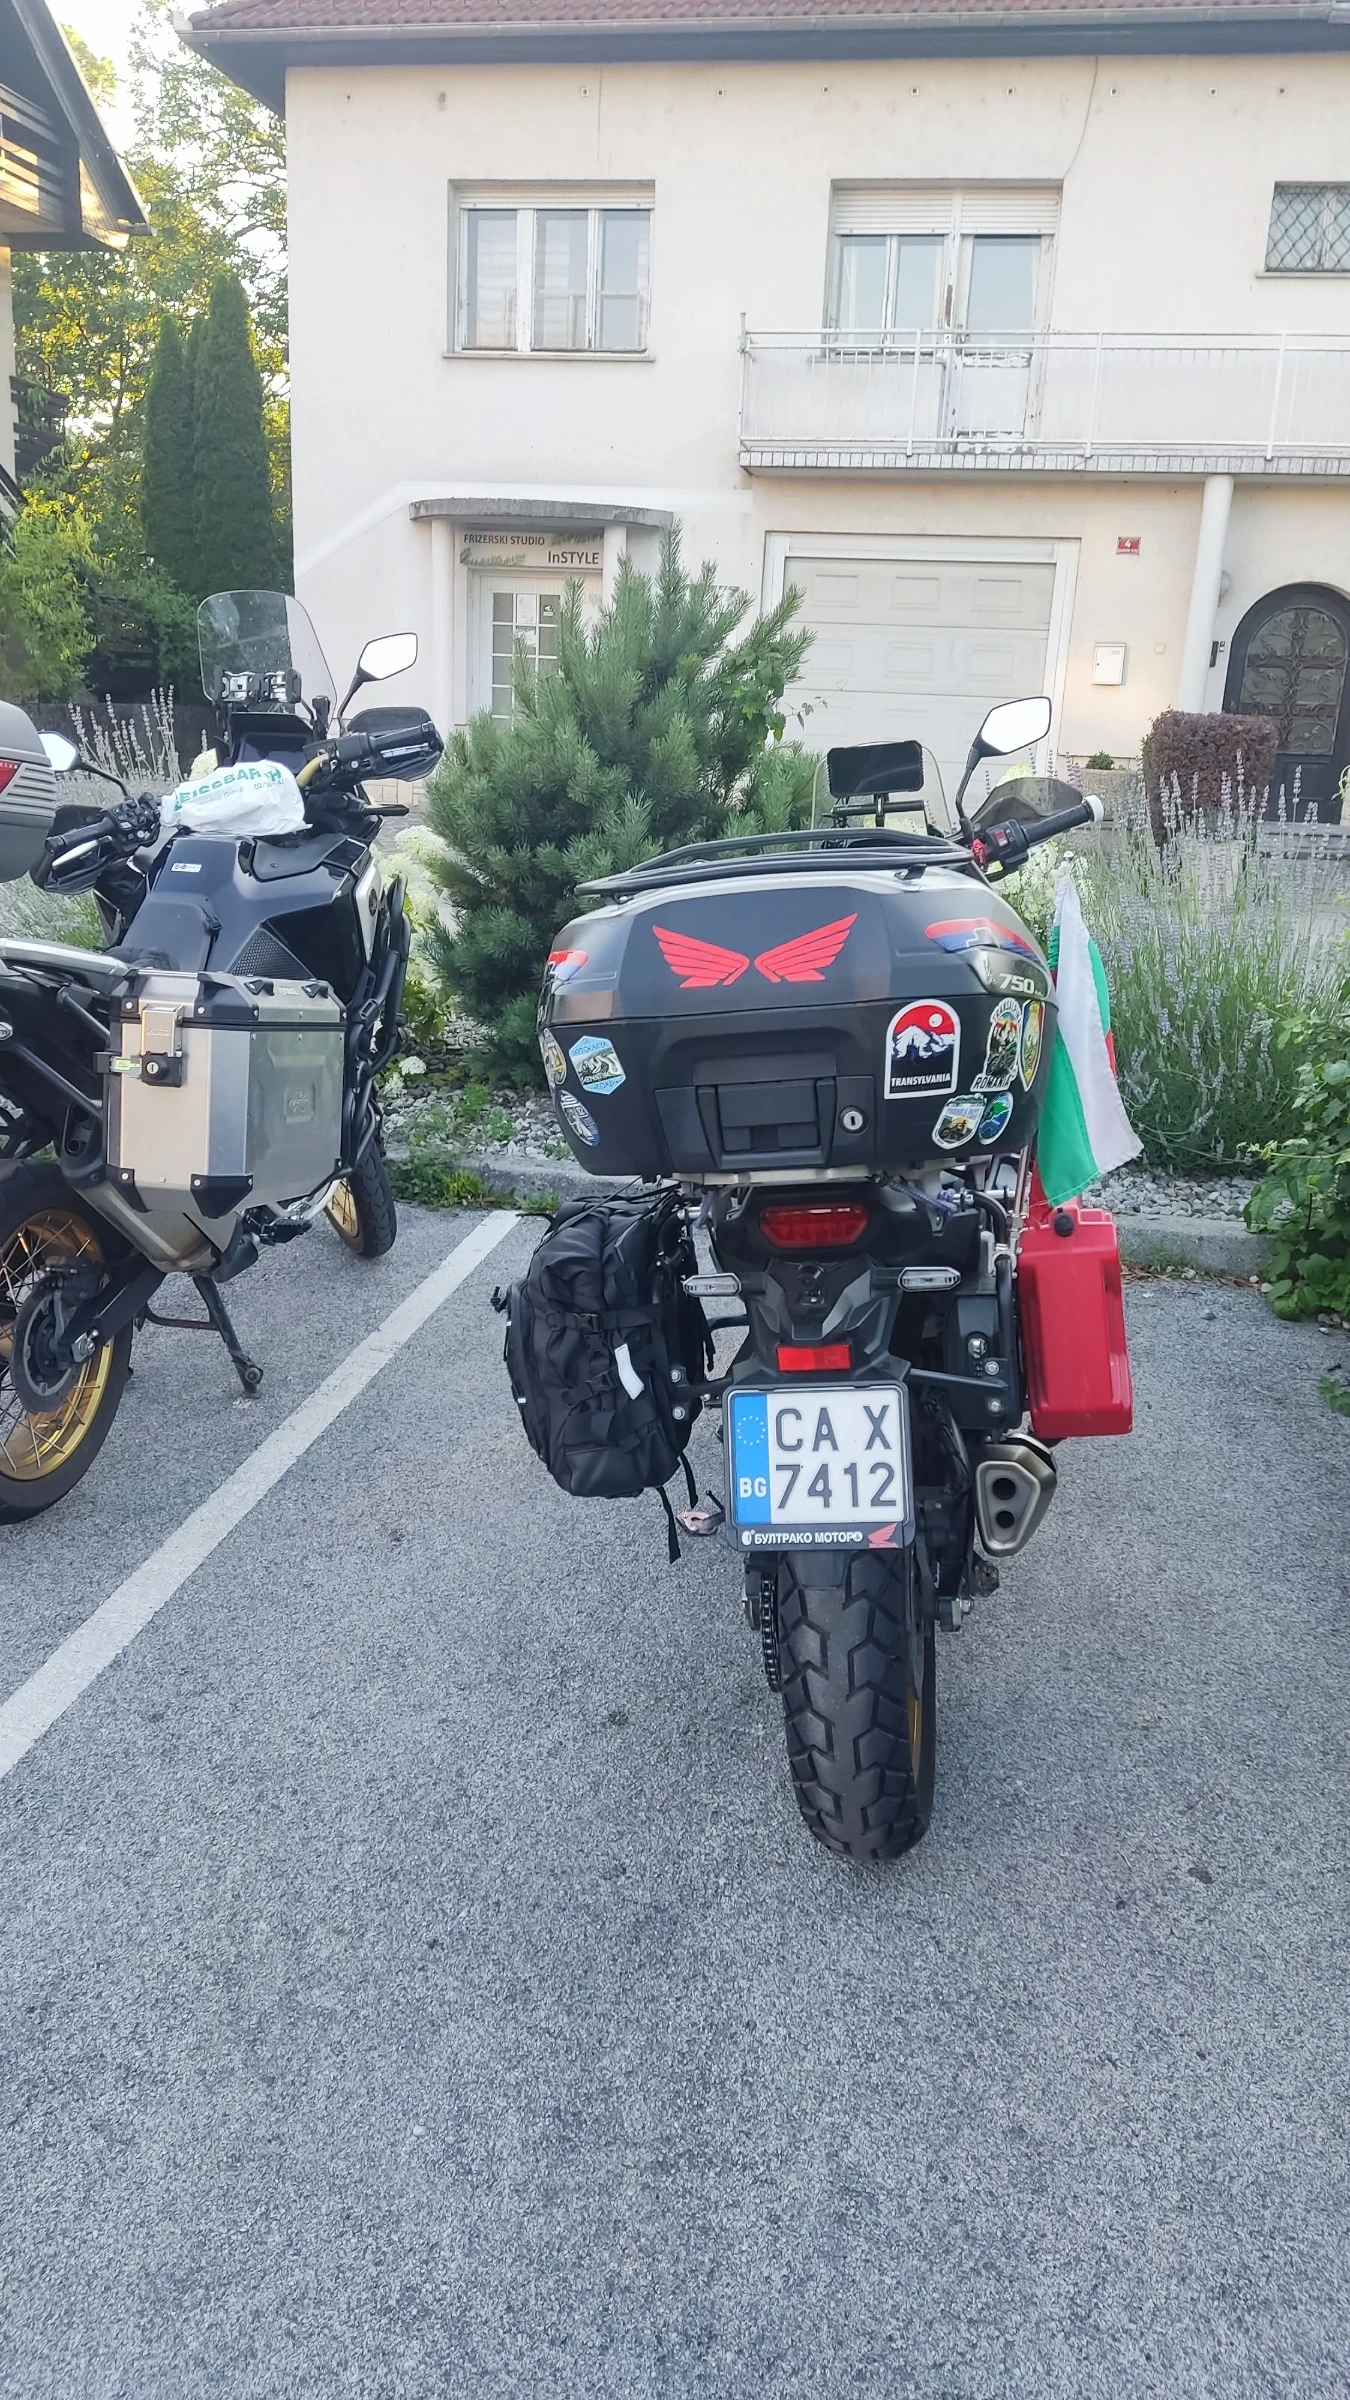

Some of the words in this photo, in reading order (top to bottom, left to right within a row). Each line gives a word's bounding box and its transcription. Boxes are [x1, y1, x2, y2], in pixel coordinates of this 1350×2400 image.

[463, 534, 508, 545] FRIZERSKI
[510, 535, 545, 546] STUDIO
[1124, 539, 1131, 548] 4
[548, 550, 600, 565] InSTYLE
[999, 973, 1035, 995] 750
[891, 1072, 951, 1087] TRANSYLVANIA
[775, 1407, 839, 1452] CA
[863, 1404, 892, 1450] X
[739, 1477, 767, 1498] BG
[775, 1462, 897, 1509] 7412
[754, 1531, 812, 1545] БУЛТРАКО
